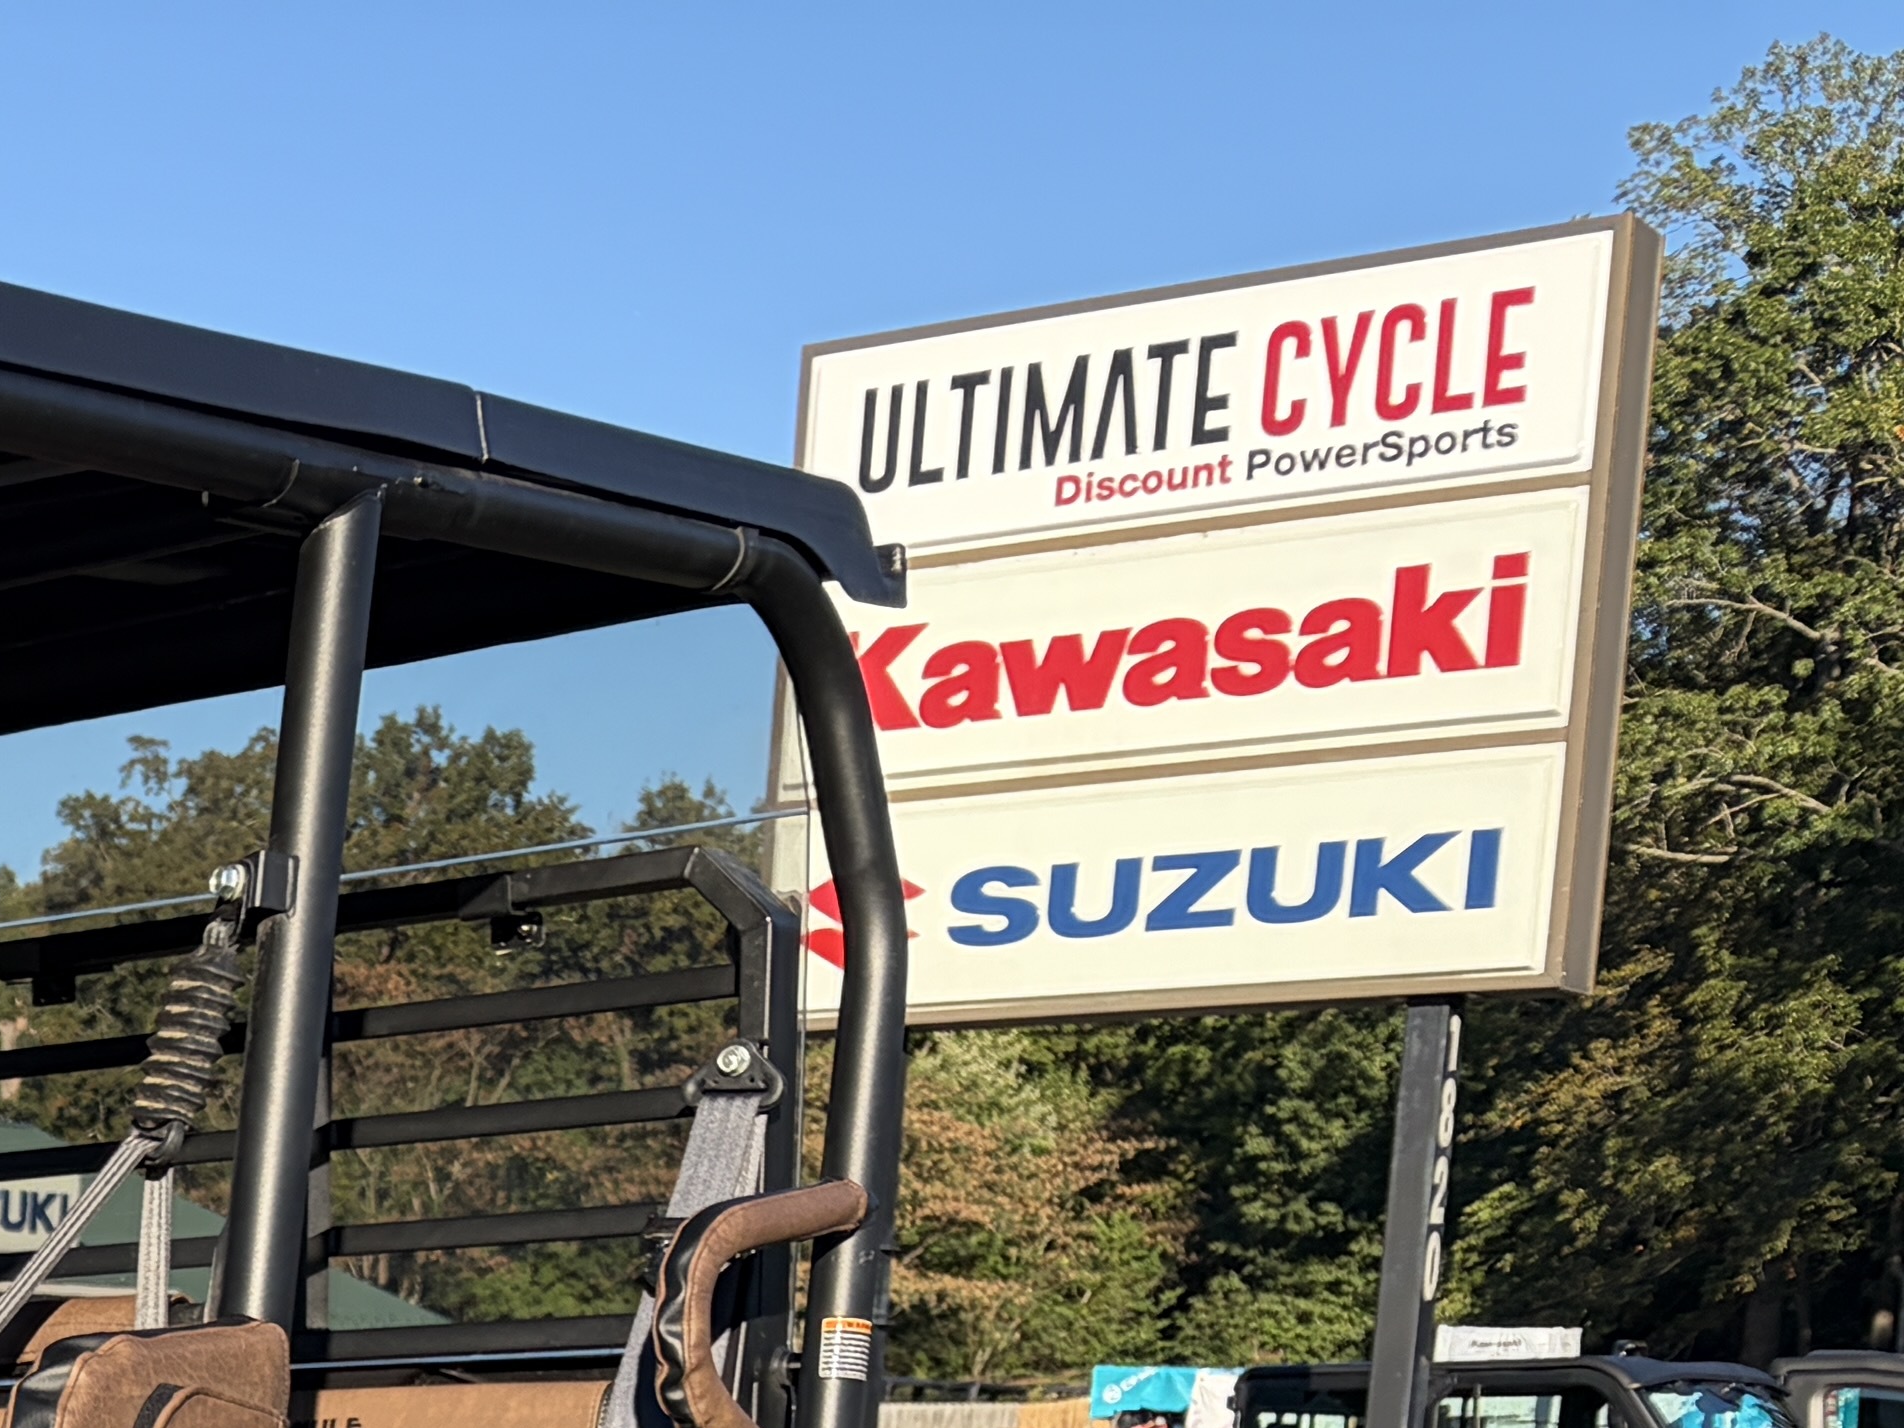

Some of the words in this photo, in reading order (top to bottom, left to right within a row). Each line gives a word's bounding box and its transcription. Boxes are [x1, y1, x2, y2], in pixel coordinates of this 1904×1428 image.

[858, 331, 1238, 494] ULTIMATE
[1258, 286, 1537, 437] CYCLE
[1053, 454, 1234, 507] Discount
[1245, 417, 1520, 482] PowerSports
[849, 552, 1531, 731] Kawasaki
[946, 827, 1506, 948] SUZUKI
